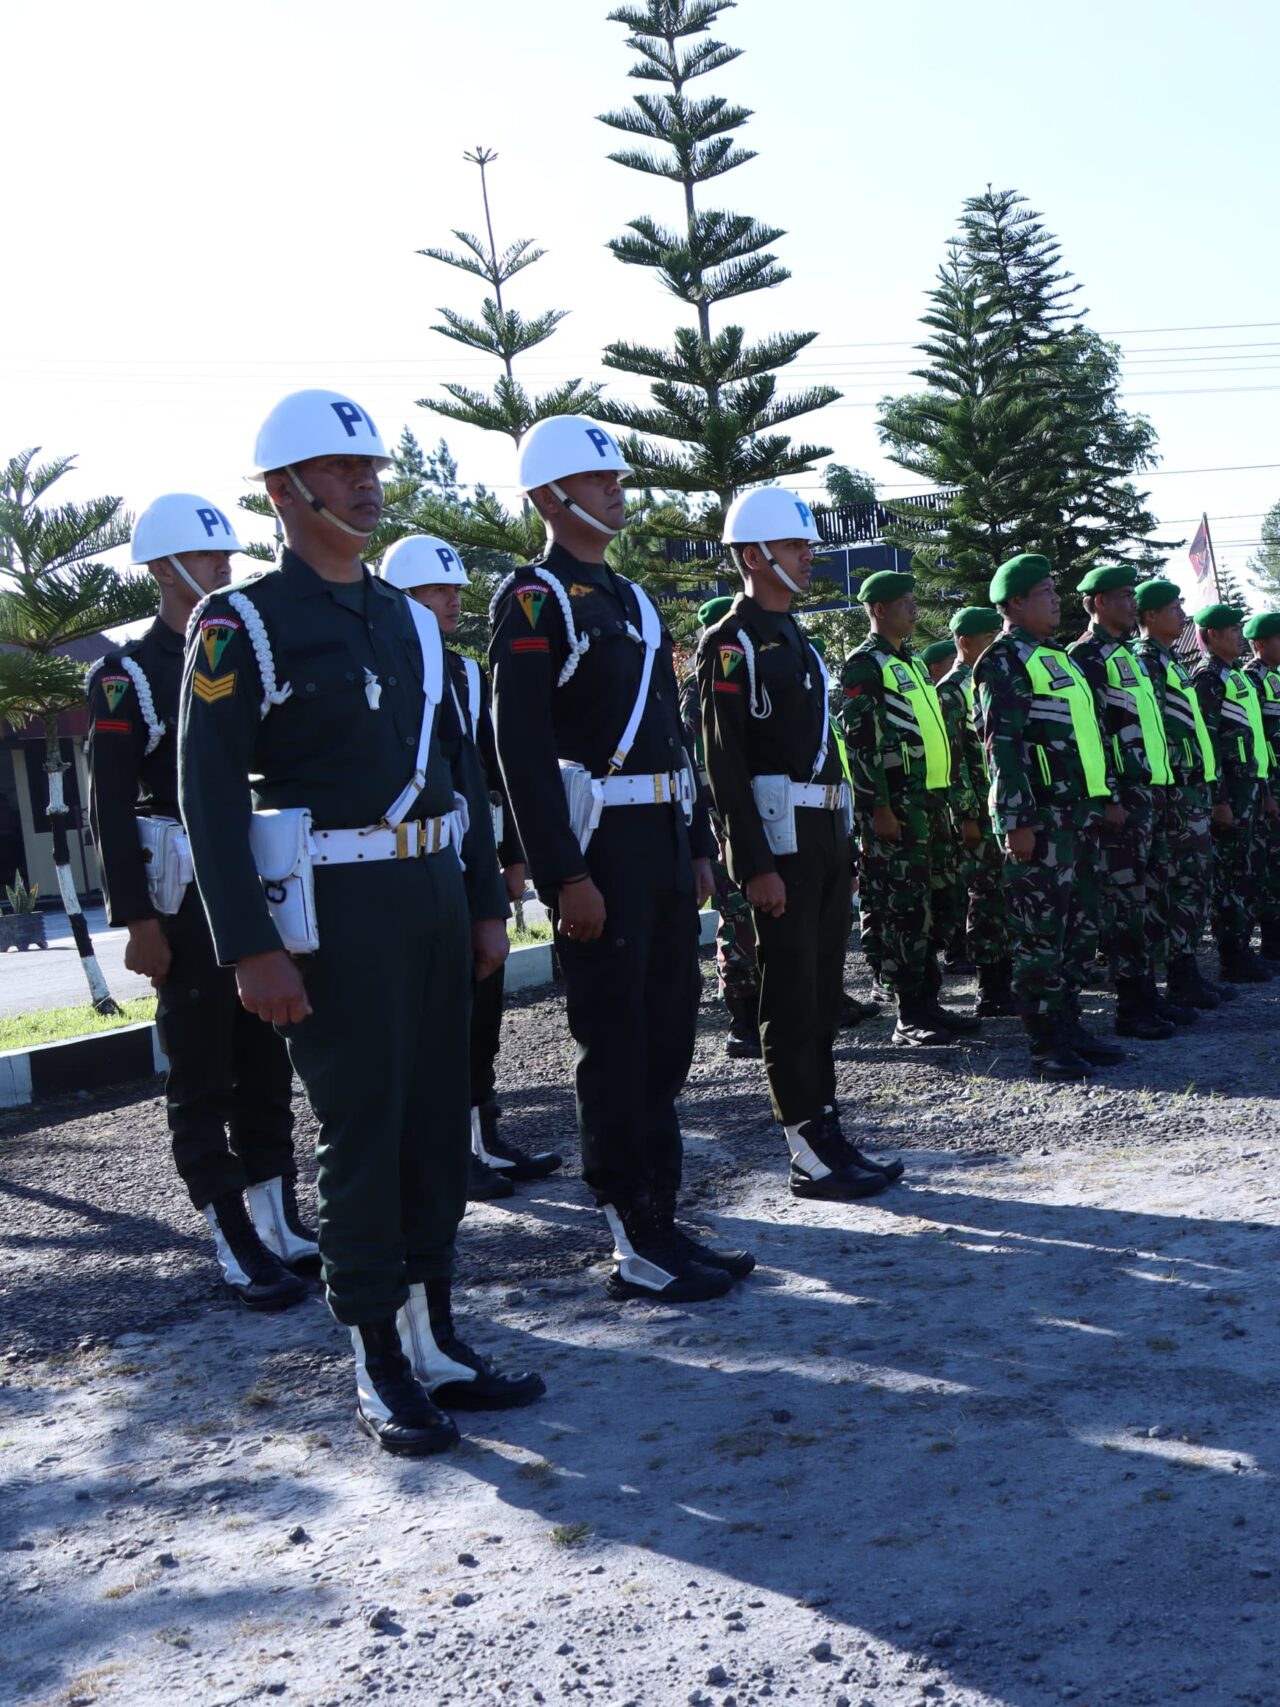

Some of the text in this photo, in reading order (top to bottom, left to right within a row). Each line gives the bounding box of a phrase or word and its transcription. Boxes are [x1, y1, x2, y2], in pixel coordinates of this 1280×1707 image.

[331, 402, 377, 437] P
[585, 428, 619, 457] P
[794, 502, 815, 528] P
[436, 548, 462, 572] P
[523, 592, 542, 603] PM
[207, 628, 228, 641] PM
[723, 652, 738, 663] PM
[106, 684, 124, 694] PM
